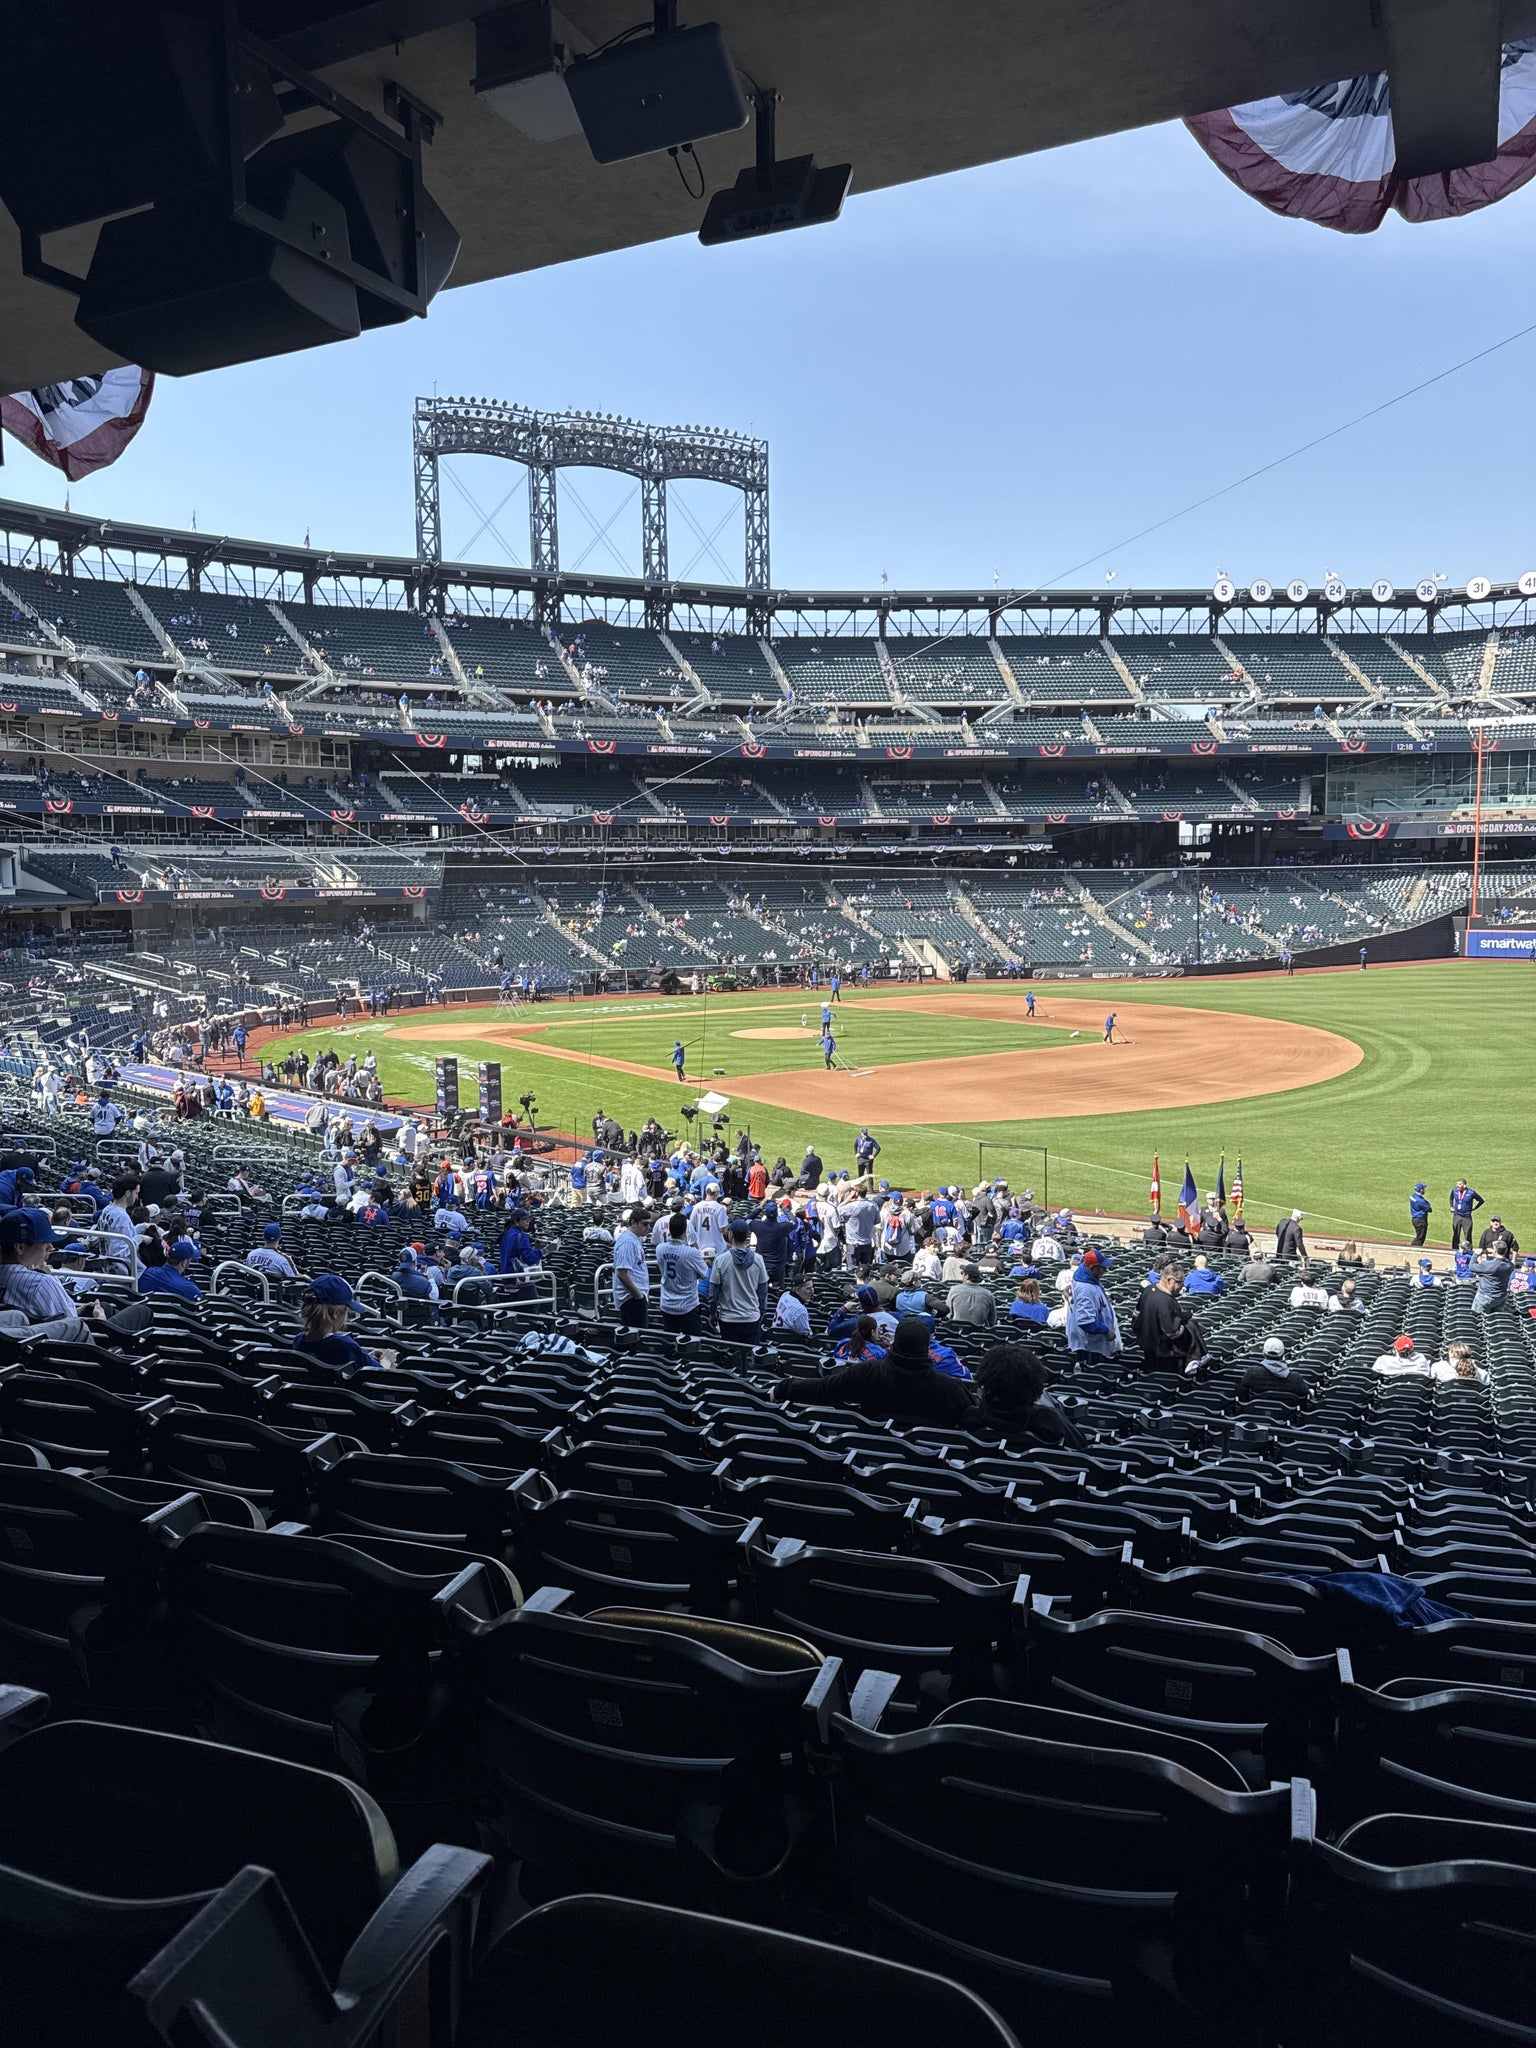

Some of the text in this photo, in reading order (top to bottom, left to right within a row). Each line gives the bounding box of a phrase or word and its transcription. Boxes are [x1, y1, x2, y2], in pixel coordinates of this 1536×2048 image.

[1473, 583, 1484, 593] 31
[1525, 578, 1536, 589] 41
[1221, 585, 1228, 596] 5
[1256, 585, 1266, 596] 18
[1293, 585, 1302, 596] 16
[1329, 585, 1342, 596] 24
[1378, 585, 1387, 596] 17
[1420, 585, 1433, 596] 36
[1457, 824, 1488, 834] OPENNG
[1489, 824, 1504, 833] DAY
[1504, 823, 1523, 832] 2026
[97, 1110, 107, 1120] 41
[416, 1190, 430, 1203] 30
[701, 1216, 710, 1231] 4
[1039, 1245, 1054, 1256] 34
[250, 1255, 272, 1266] SEAVER
[666, 1261, 677, 1280] 5
[1510, 1279, 1530, 1293] 22
